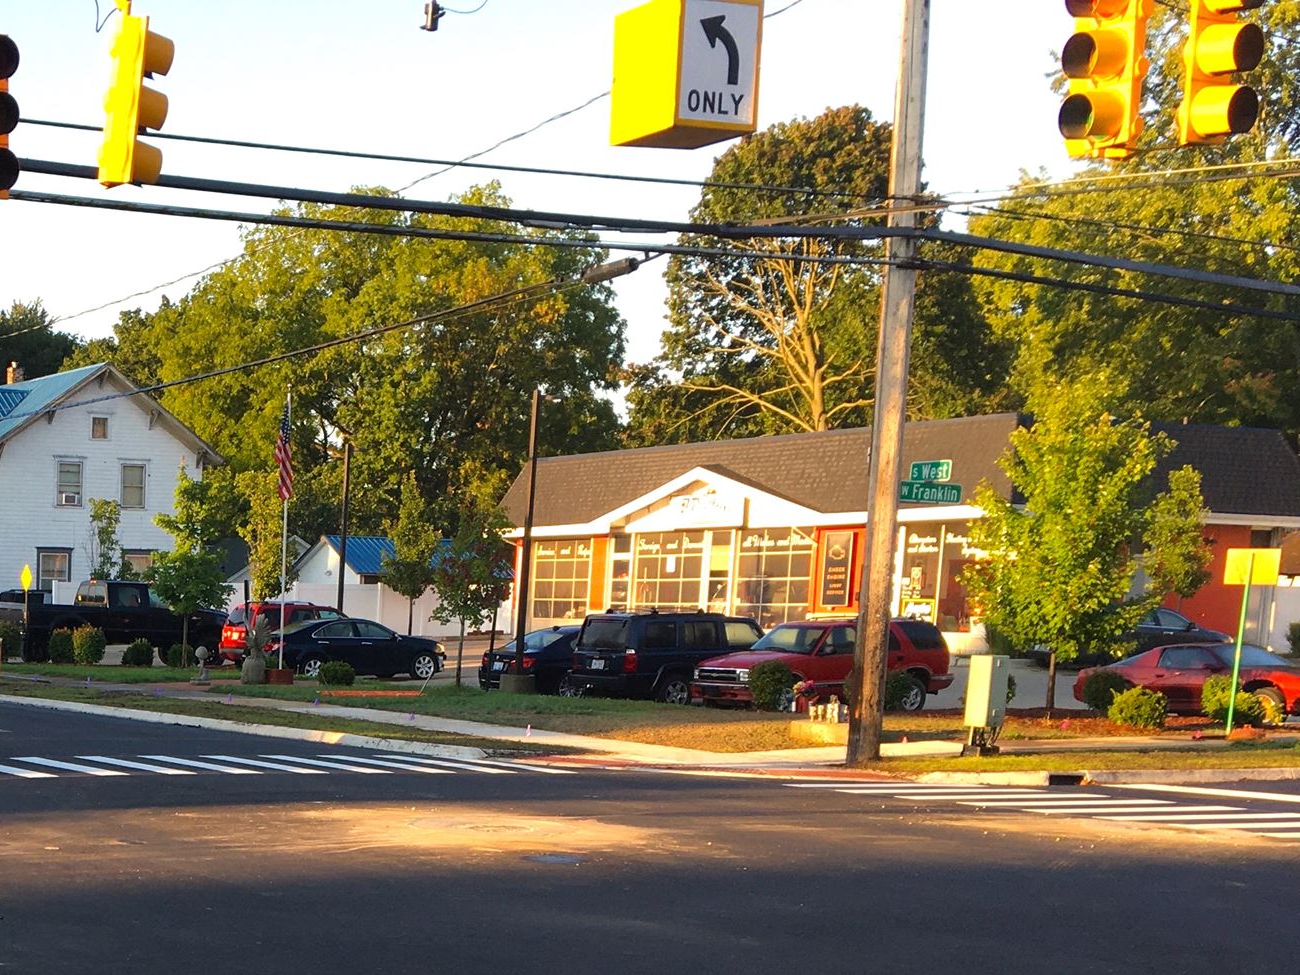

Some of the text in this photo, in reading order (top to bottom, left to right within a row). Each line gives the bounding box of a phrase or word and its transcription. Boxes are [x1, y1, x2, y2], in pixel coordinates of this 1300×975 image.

[688, 89, 745, 116] ONLY
[922, 463, 949, 479] West
[912, 484, 958, 502] Franklin
